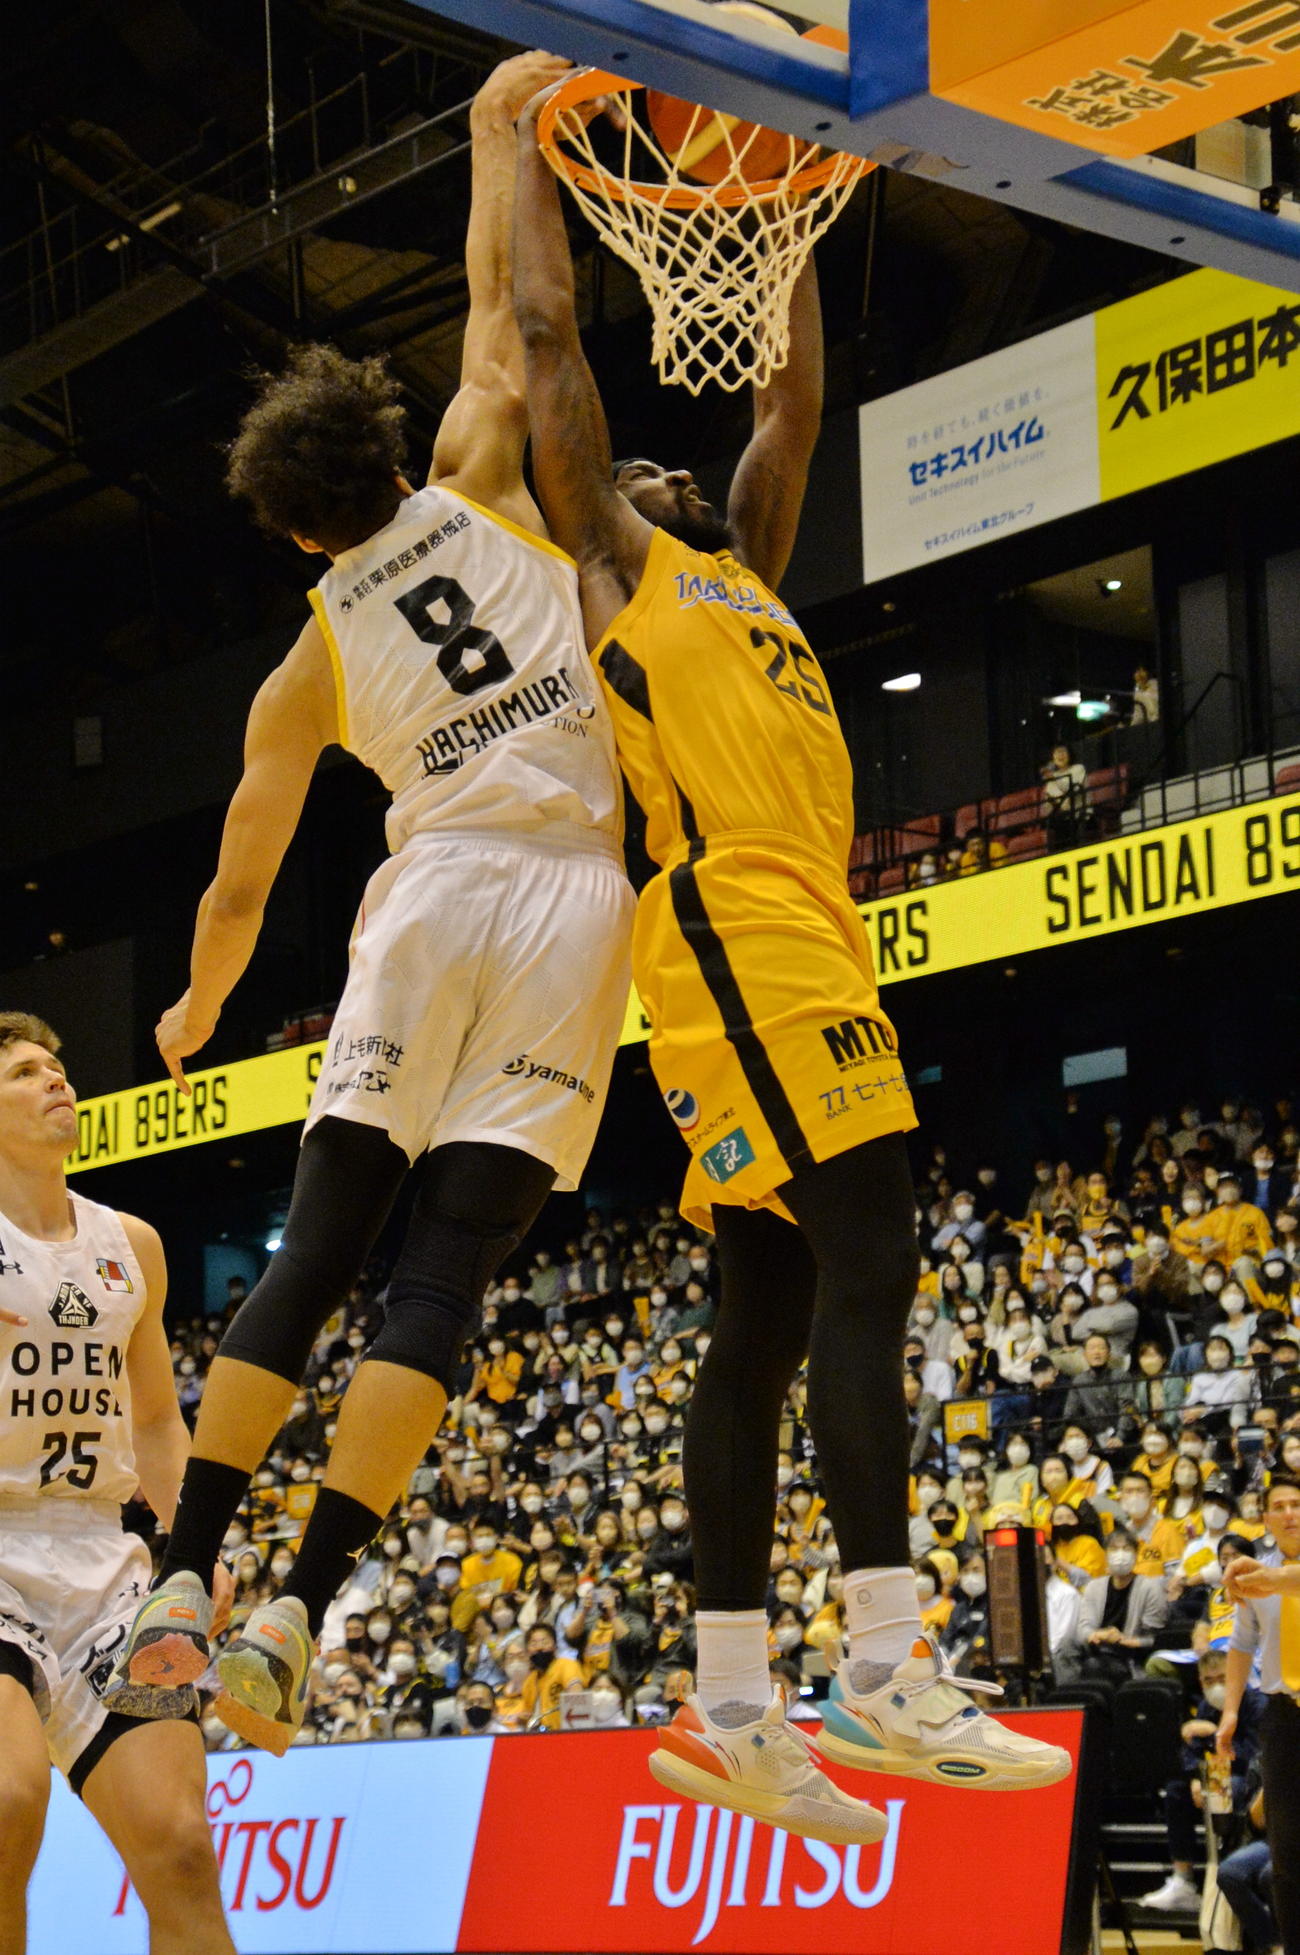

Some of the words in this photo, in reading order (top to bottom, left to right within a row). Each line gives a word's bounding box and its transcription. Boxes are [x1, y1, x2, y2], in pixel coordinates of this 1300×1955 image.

[908, 415, 1046, 487] セキスイハイム
[393, 574, 516, 697] 8
[749, 625, 833, 719] 25
[1045, 827, 1216, 935] SENDAI
[134, 1075, 228, 1148] 89ERS
[11, 1341, 123, 1381] OPEN
[39, 1431, 102, 1490] 25
[607, 1799, 906, 1947] FUJITSU
